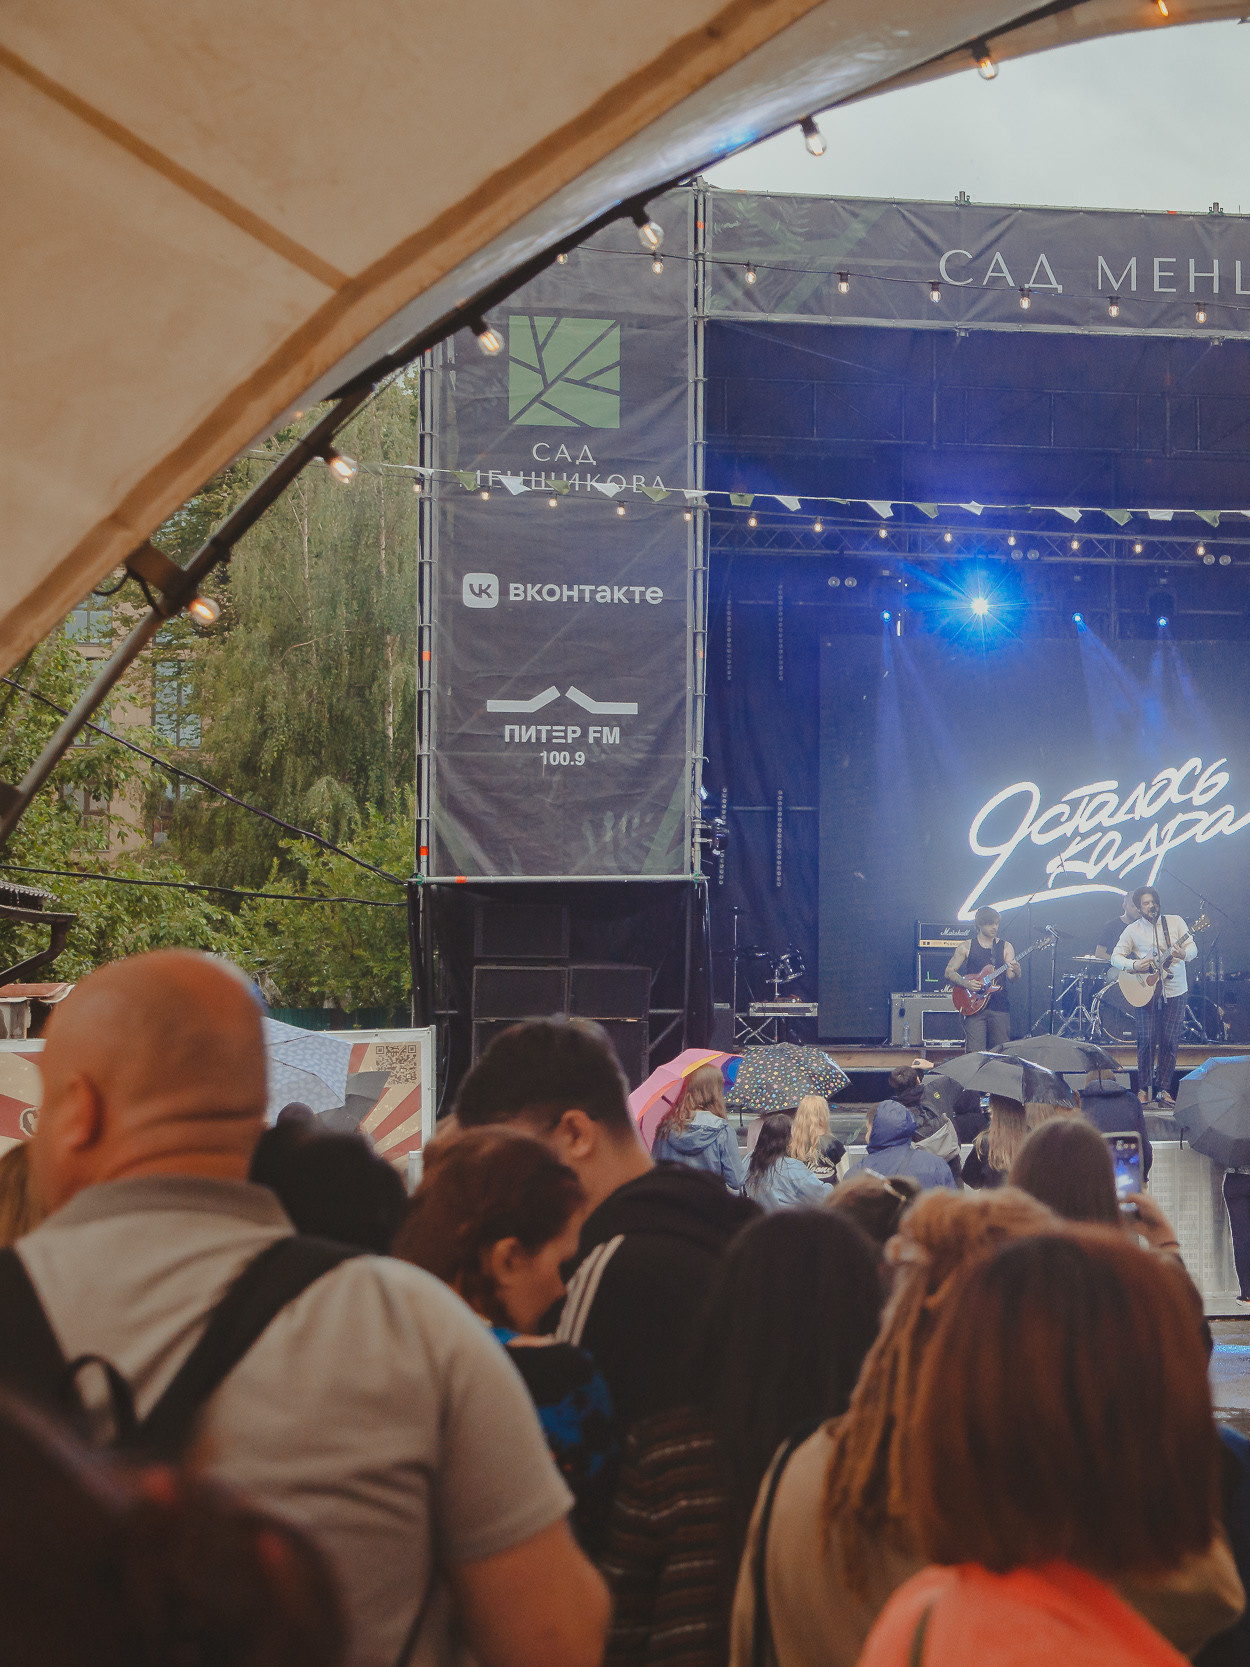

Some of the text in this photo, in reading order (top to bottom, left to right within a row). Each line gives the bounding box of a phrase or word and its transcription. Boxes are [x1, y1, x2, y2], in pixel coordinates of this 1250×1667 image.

[939, 249, 1063, 293] САД
[532, 442, 597, 465] САД
[504, 725, 620, 744] ПИТЕР FM
[540, 751, 586, 766] 100.9
[940, 927, 971, 936] Marshall
